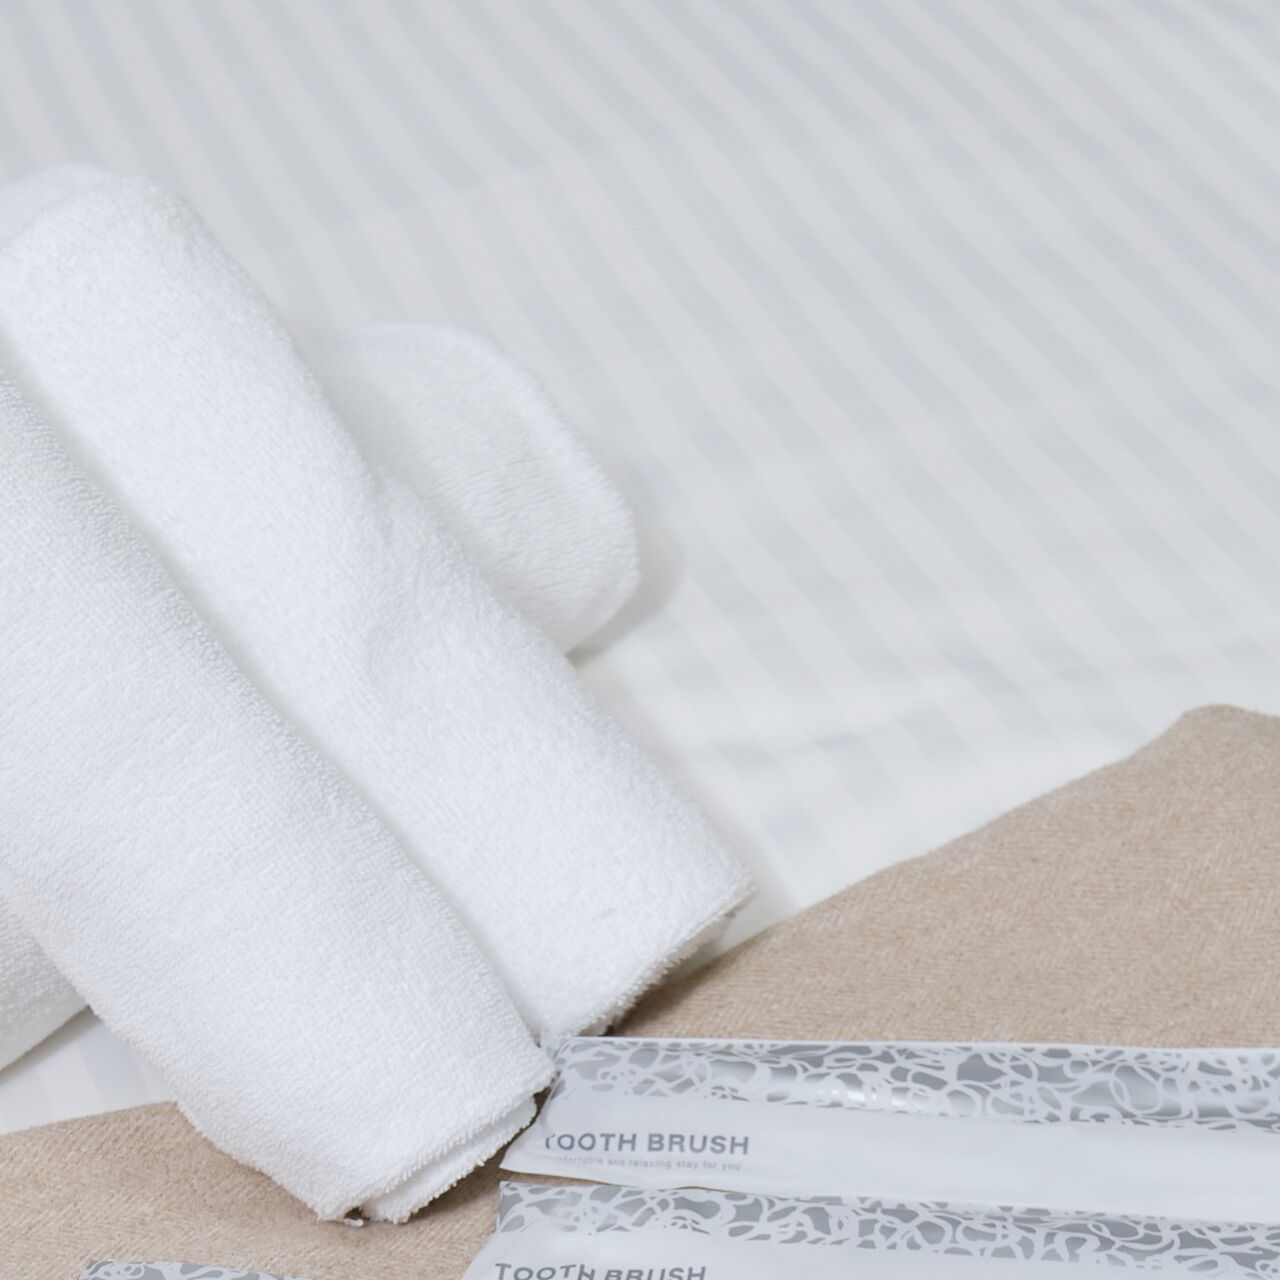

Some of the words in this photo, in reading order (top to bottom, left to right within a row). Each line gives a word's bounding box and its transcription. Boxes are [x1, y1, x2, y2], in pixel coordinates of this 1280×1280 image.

[647, 1133, 750, 1155] BRUSH
[607, 1156, 626, 1167] and
[628, 1157, 672, 1170] relaxing
[676, 1159, 699, 1171] stay
[702, 1160, 718, 1170] for
[721, 1162, 742, 1173] you
